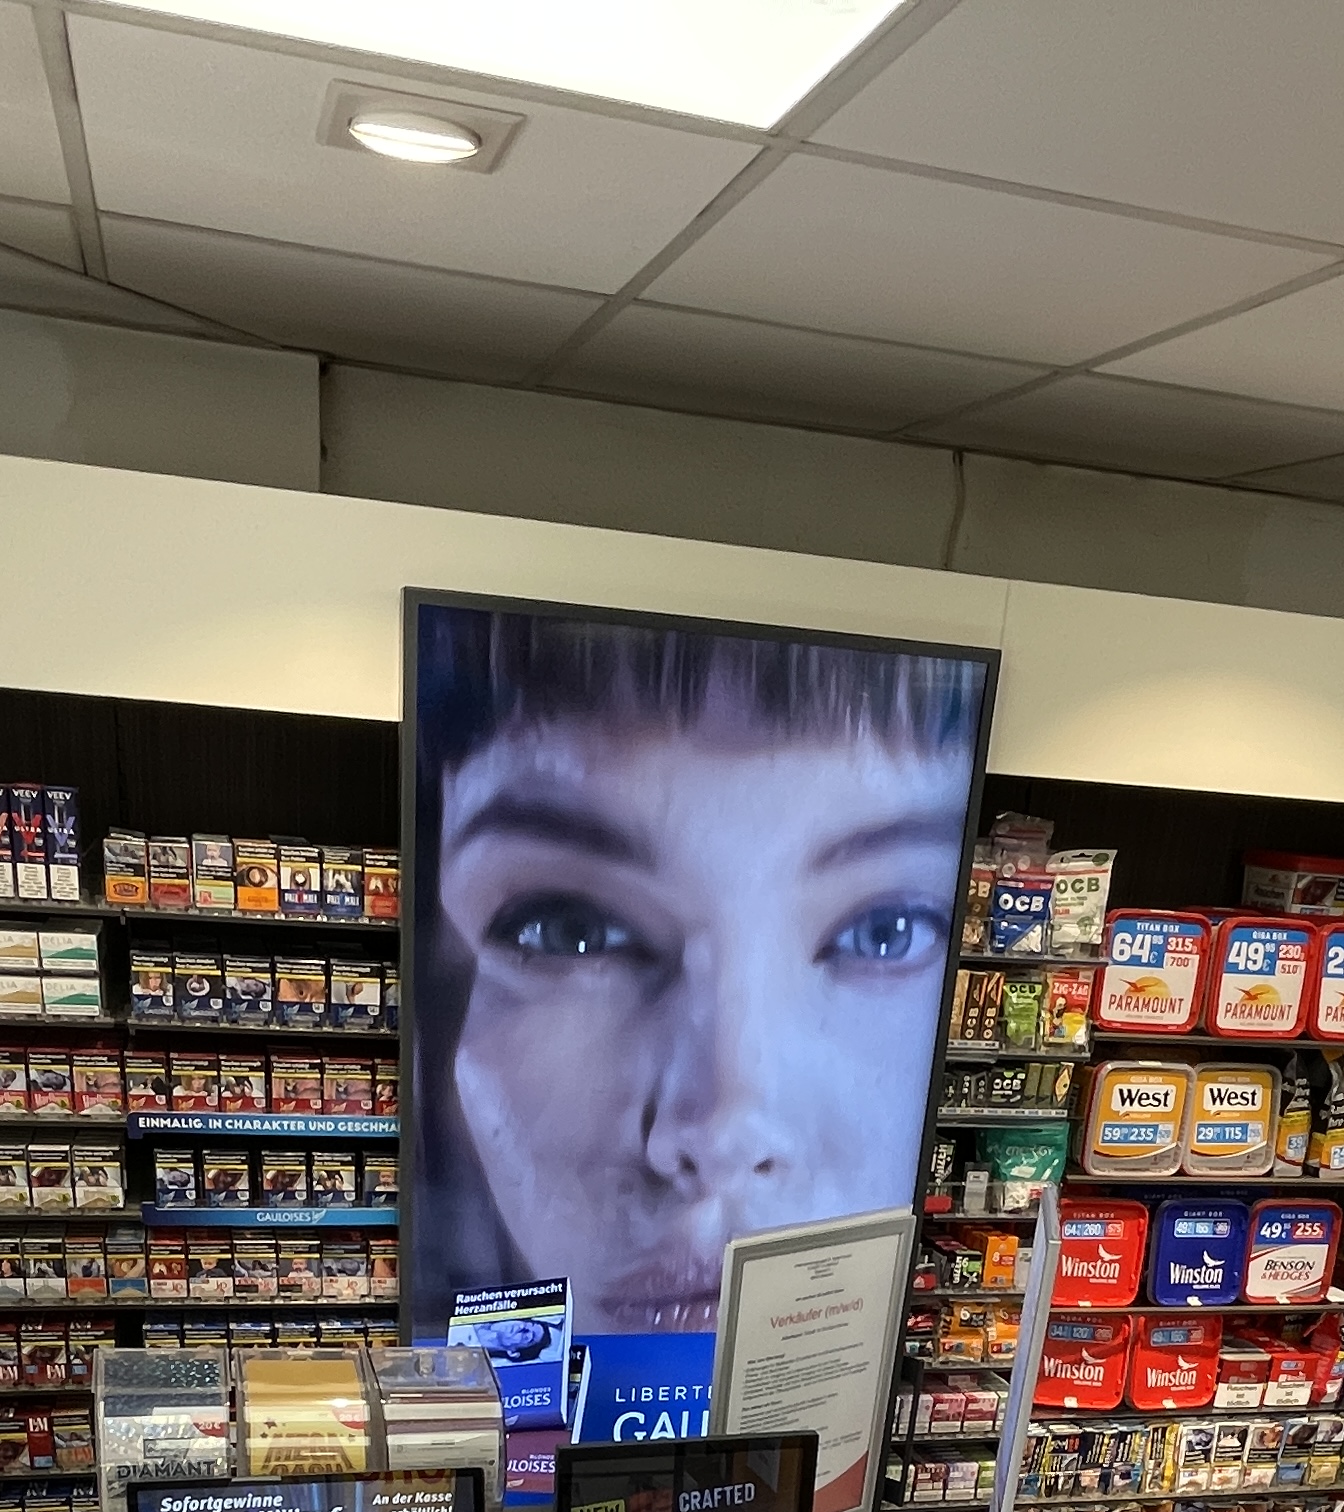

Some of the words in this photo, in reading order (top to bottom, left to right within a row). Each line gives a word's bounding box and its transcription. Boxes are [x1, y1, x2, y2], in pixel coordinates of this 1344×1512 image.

[12, 787, 38, 800] VEEV
[46, 789, 72, 802] VEEV
[1055, 877, 1100, 894] OCB
[998, 892, 1044, 912] OCB
[1137, 922, 1159, 932] TITAN
[1162, 924, 1180, 933] BOX
[1112, 933, 1150, 963] 64
[1228, 942, 1264, 971] 49
[1008, 984, 1037, 994] OCB
[1108, 993, 1184, 1016] PARAMOUNT
[1224, 1002, 1293, 1021] PARAMOUNT
[1117, 1088, 1172, 1109] West
[1208, 1087, 1258, 1107] West
[138, 1116, 206, 1131] EINMALIG.
[208, 1118, 223, 1130] IN
[224, 1118, 305, 1132] CHARAKTER
[308, 1120, 334, 1132] UND
[256, 1209, 312, 1223] GAULOISES
[1294, 1221, 1323, 1238] 255
[1061, 1256, 1121, 1280] Winston
[1169, 1260, 1223, 1286] Winston
[1263, 1259, 1316, 1272] BENSON
[456, 1291, 501, 1305] Rauchen
[503, 1283, 564, 1299] verursacht
[455, 1299, 518, 1315] Herzanfälle
[770, 1307, 822, 1330] Verkäufer
[1044, 1356, 1105, 1381] Winston
[1146, 1367, 1198, 1388] Winston
[160, 1493, 283, 1512] Sofortgewinne
[372, 1493, 389, 1506] An
[392, 1492, 412, 1505] der
[414, 1491, 452, 1504] Kasse
[678, 1483, 755, 1512] CRAFTED
